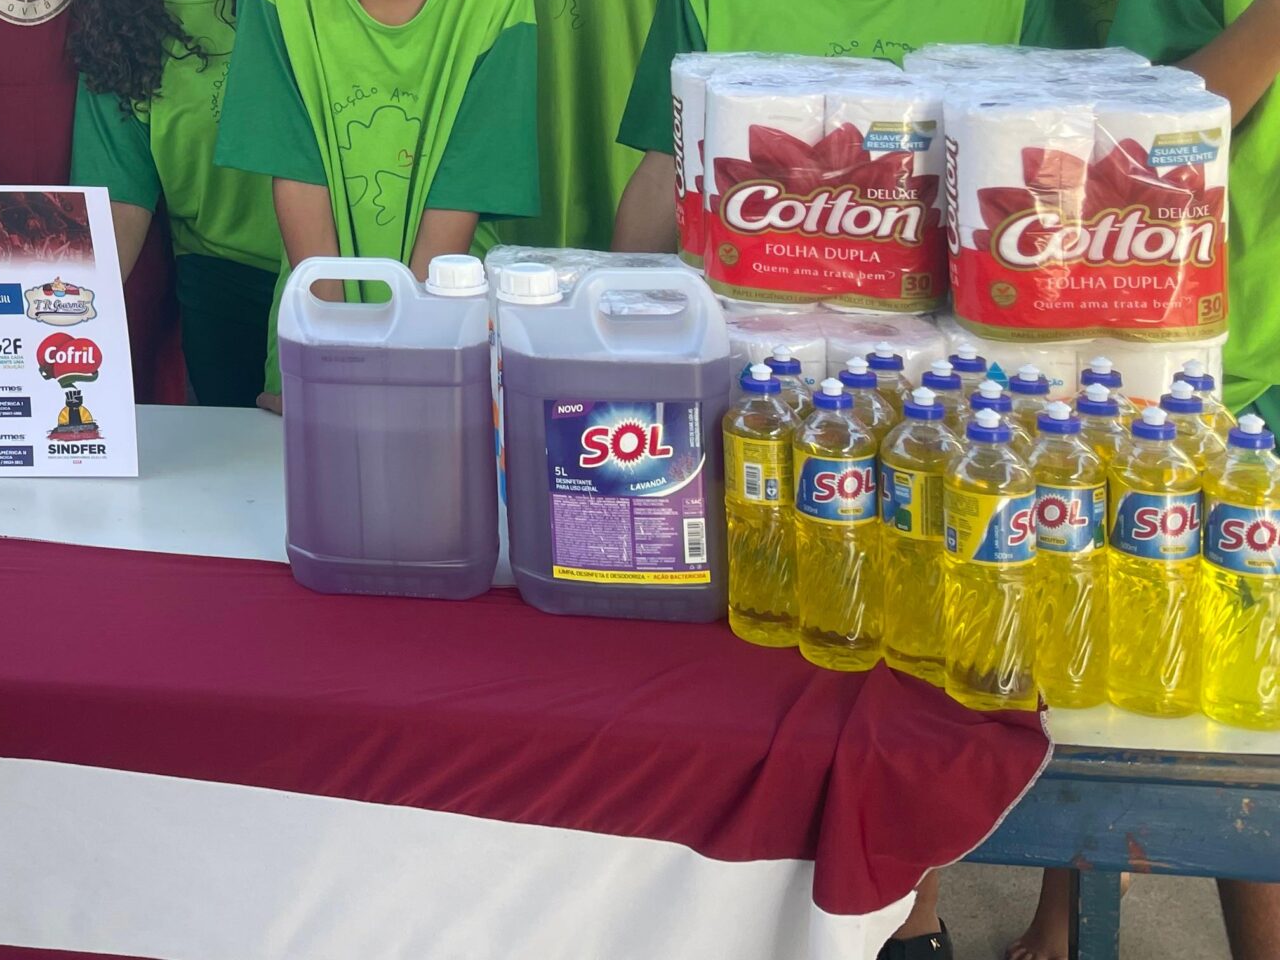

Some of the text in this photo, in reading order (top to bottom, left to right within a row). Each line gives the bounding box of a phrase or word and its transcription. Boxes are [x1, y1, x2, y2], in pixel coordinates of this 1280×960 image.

[1151, 151, 1216, 165] RESISTENTE
[1154, 146, 1189, 156] SUAVE
[867, 188, 918, 201] DELUXE
[725, 184, 922, 243] Cotton
[1158, 204, 1210, 220] DELUXE
[998, 210, 1214, 266] Cotton
[765, 243, 881, 263] FOLHA DUPLA
[752, 262, 886, 282] Quem ama trata bem
[903, 275, 930, 292] 30
[1047, 275, 1179, 291] FOLHA DUPLA
[53, 299, 89, 312] Gourmet
[1033, 298, 1182, 310] Quem ama trata bem
[1200, 296, 1222, 317] 30
[44, 346, 96, 364] Cofril
[557, 403, 584, 414] NOVO
[48, 444, 106, 455] SINDFER
[579, 416, 674, 470] SOL
[554, 466, 568, 477] 5L
[555, 478, 593, 486] DESINFETANTE
[630, 476, 668, 491] LAVANDA
[812, 465, 877, 503] SOL
[1036, 493, 1088, 530] OL
[1131, 501, 1201, 541] SOL
